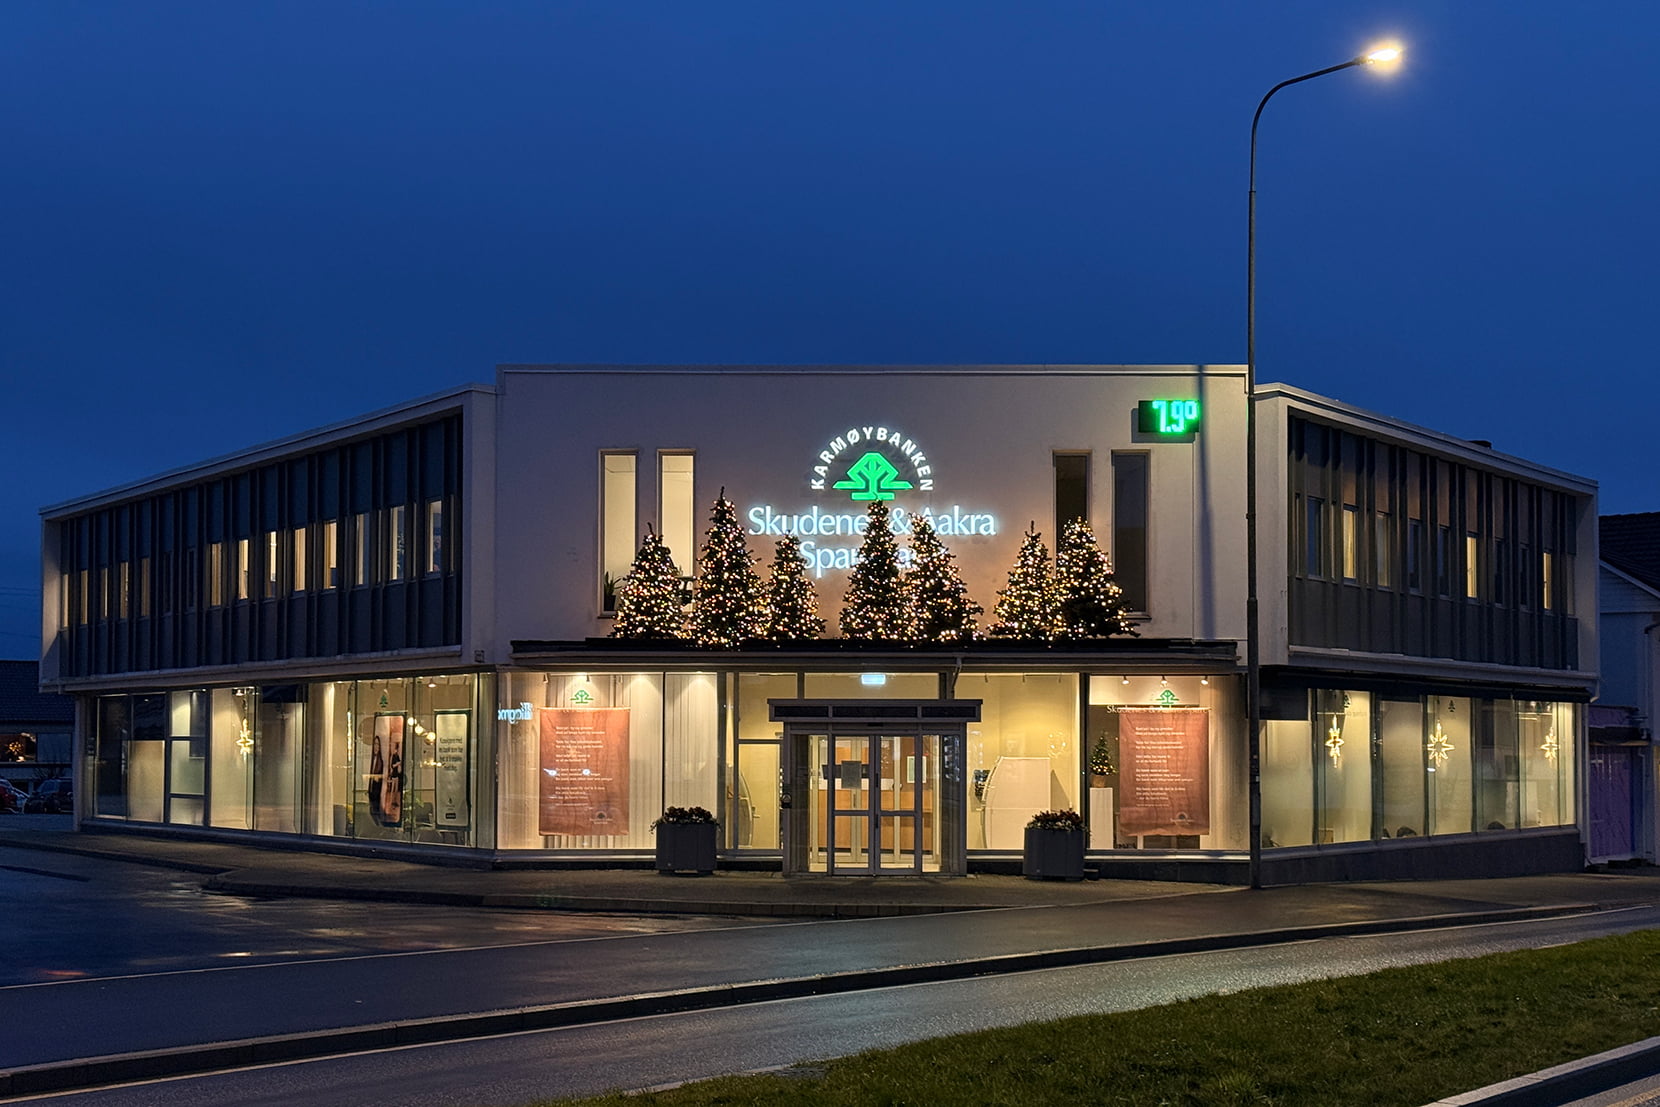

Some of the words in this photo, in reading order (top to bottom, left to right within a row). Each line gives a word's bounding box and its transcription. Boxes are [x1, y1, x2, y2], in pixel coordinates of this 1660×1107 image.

[811, 426, 933, 491] KARMØYBANKEN
[748, 505, 873, 536] Skudene
[888, 507, 911, 535] &
